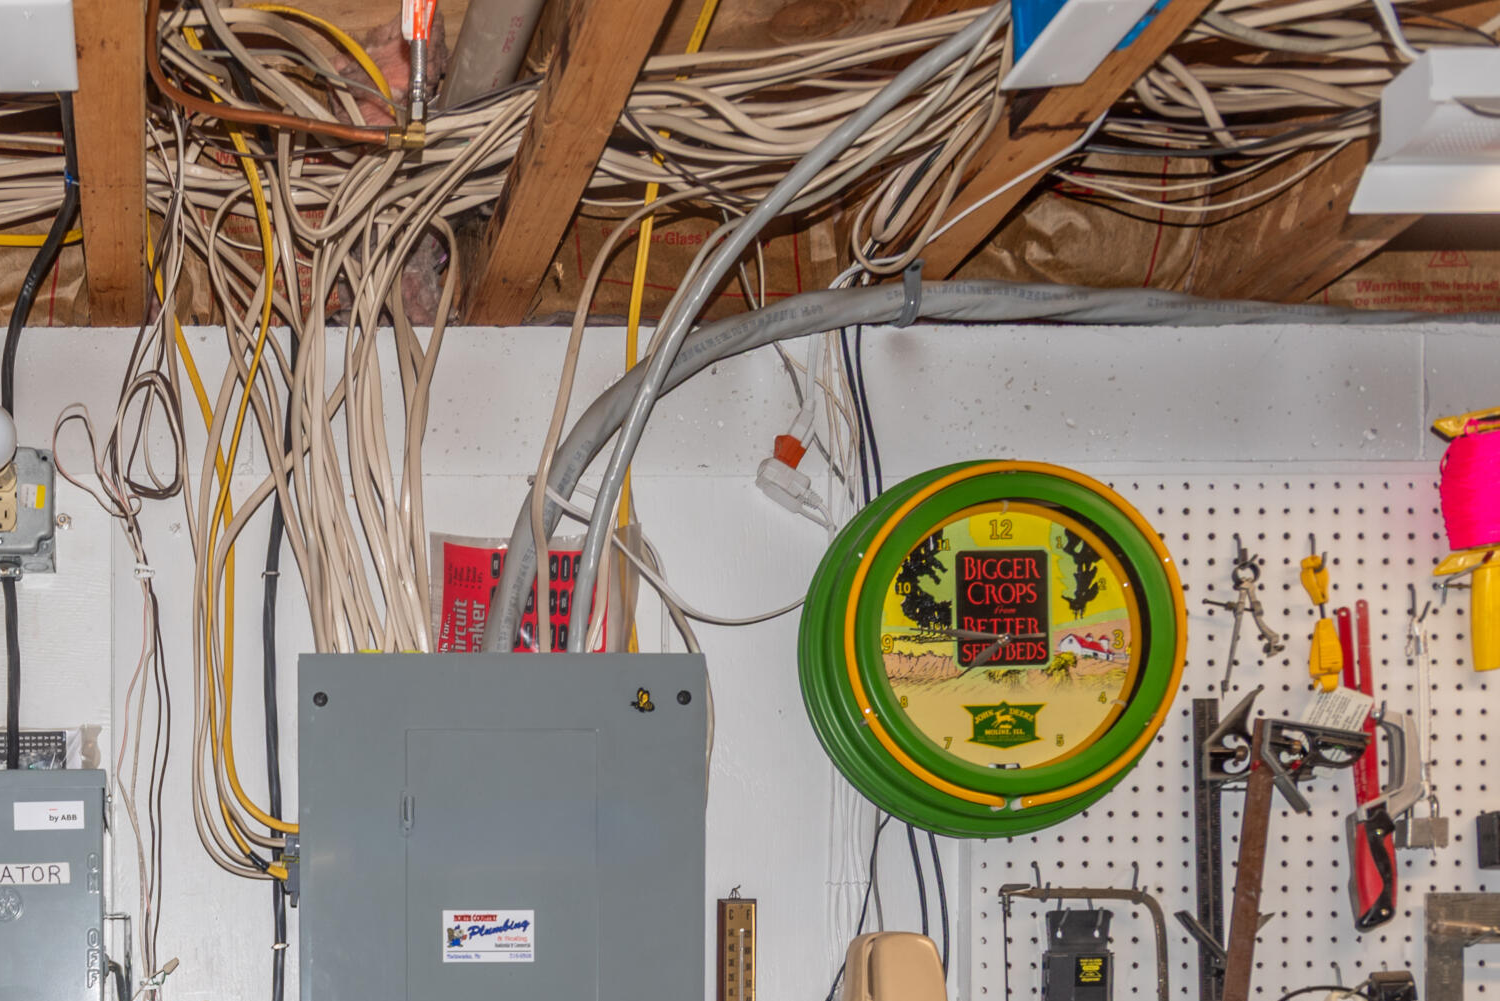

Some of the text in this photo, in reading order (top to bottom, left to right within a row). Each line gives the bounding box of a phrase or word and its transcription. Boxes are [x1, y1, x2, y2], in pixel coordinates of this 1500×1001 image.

[665, 231, 700, 246] Glass
[989, 519, 1013, 540] 12
[937, 539, 951, 551] 11
[1056, 536, 1063, 549] 1
[964, 556, 1041, 580] BIGGER
[897, 582, 911, 594] 10
[967, 581, 1037, 605] CROPS
[455, 598, 468, 651] ircuit
[468, 600, 485, 652] eaker
[964, 616, 1040, 640] BETTER
[881, 635, 894, 654] 9
[1112, 630, 1124, 649] 3
[1005, 641, 1047, 661] BEDS
[900, 696, 908, 708] 8
[1099, 692, 1107, 704] 4
[1009, 708, 1034, 722] DEERE
[944, 736, 953, 750] 7
[1056, 735, 1064, 747] 5
[49, 814, 58, 823] by
[729, 909, 734, 920] C
[467, 918, 530, 940] Plumbing
[87, 928, 100, 988] OFF
